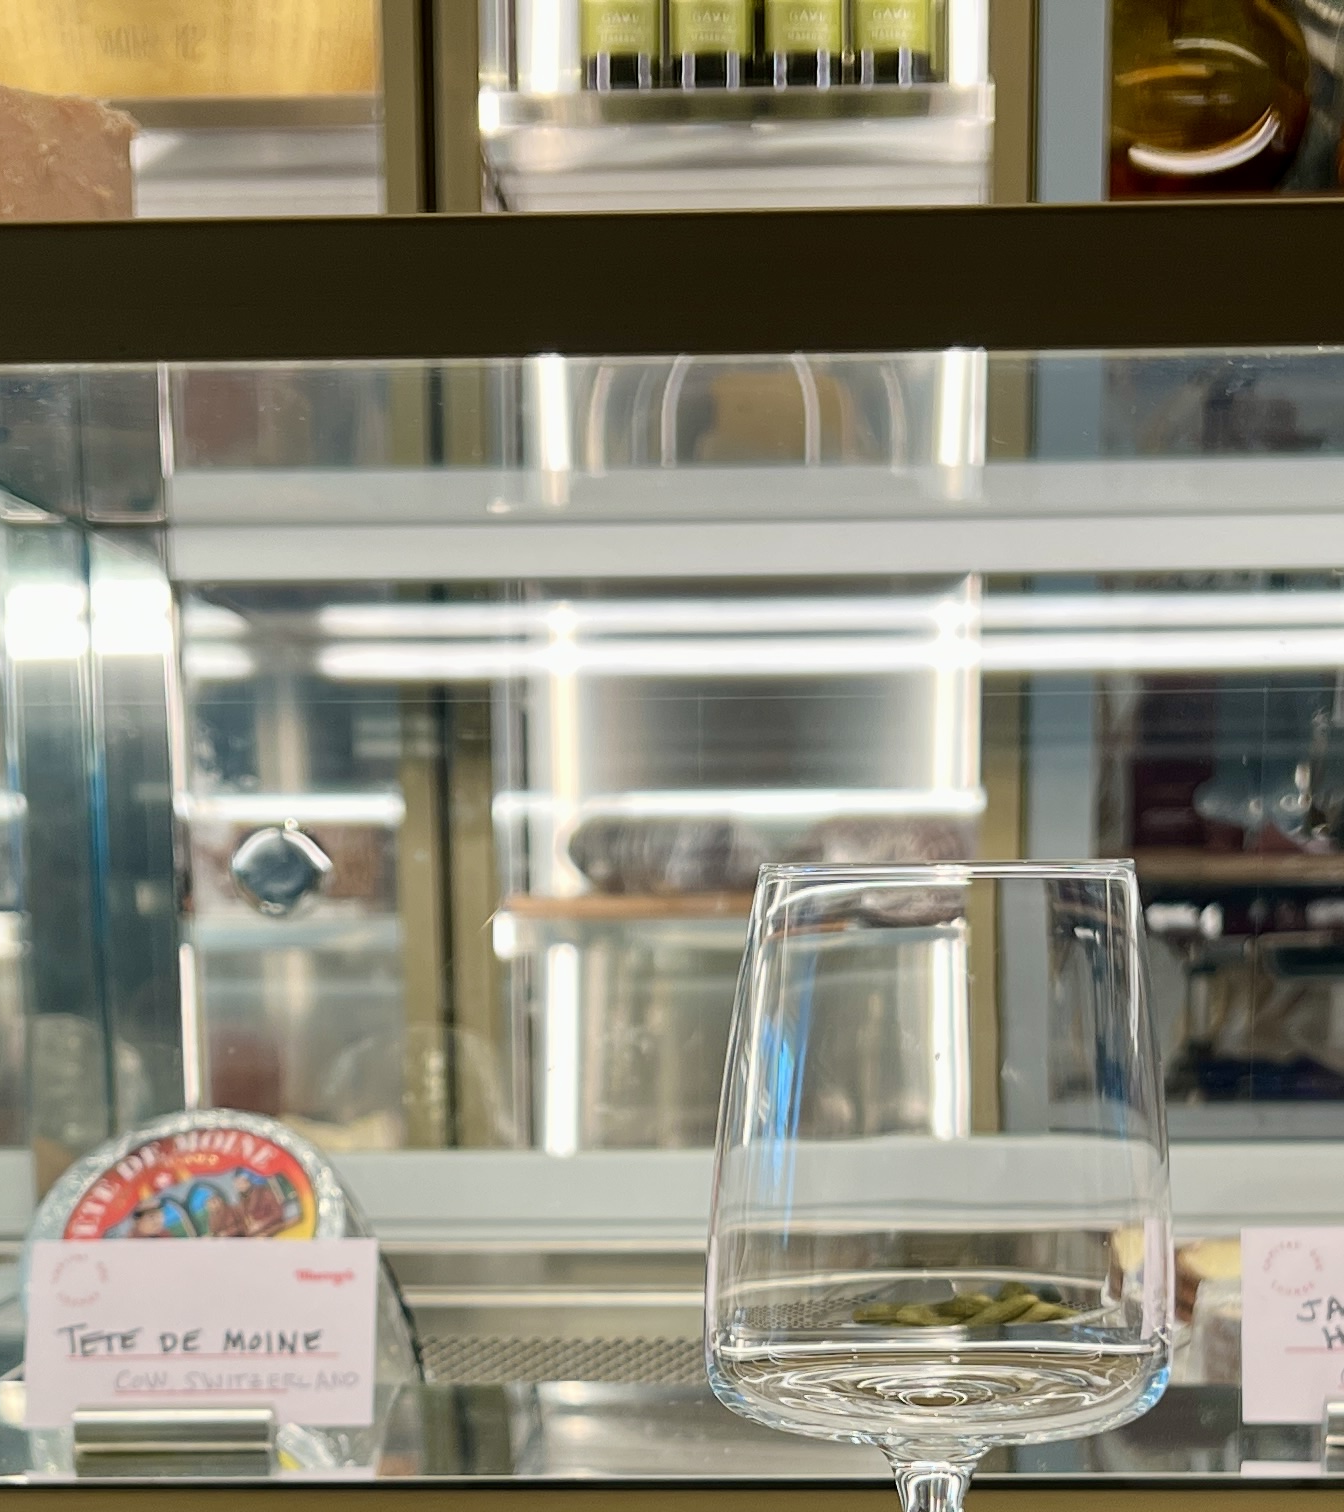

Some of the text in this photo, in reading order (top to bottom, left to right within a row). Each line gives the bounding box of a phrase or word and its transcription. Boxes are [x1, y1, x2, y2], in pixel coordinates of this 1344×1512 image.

[58, 1323, 325, 1357] TETE DE MOINE
